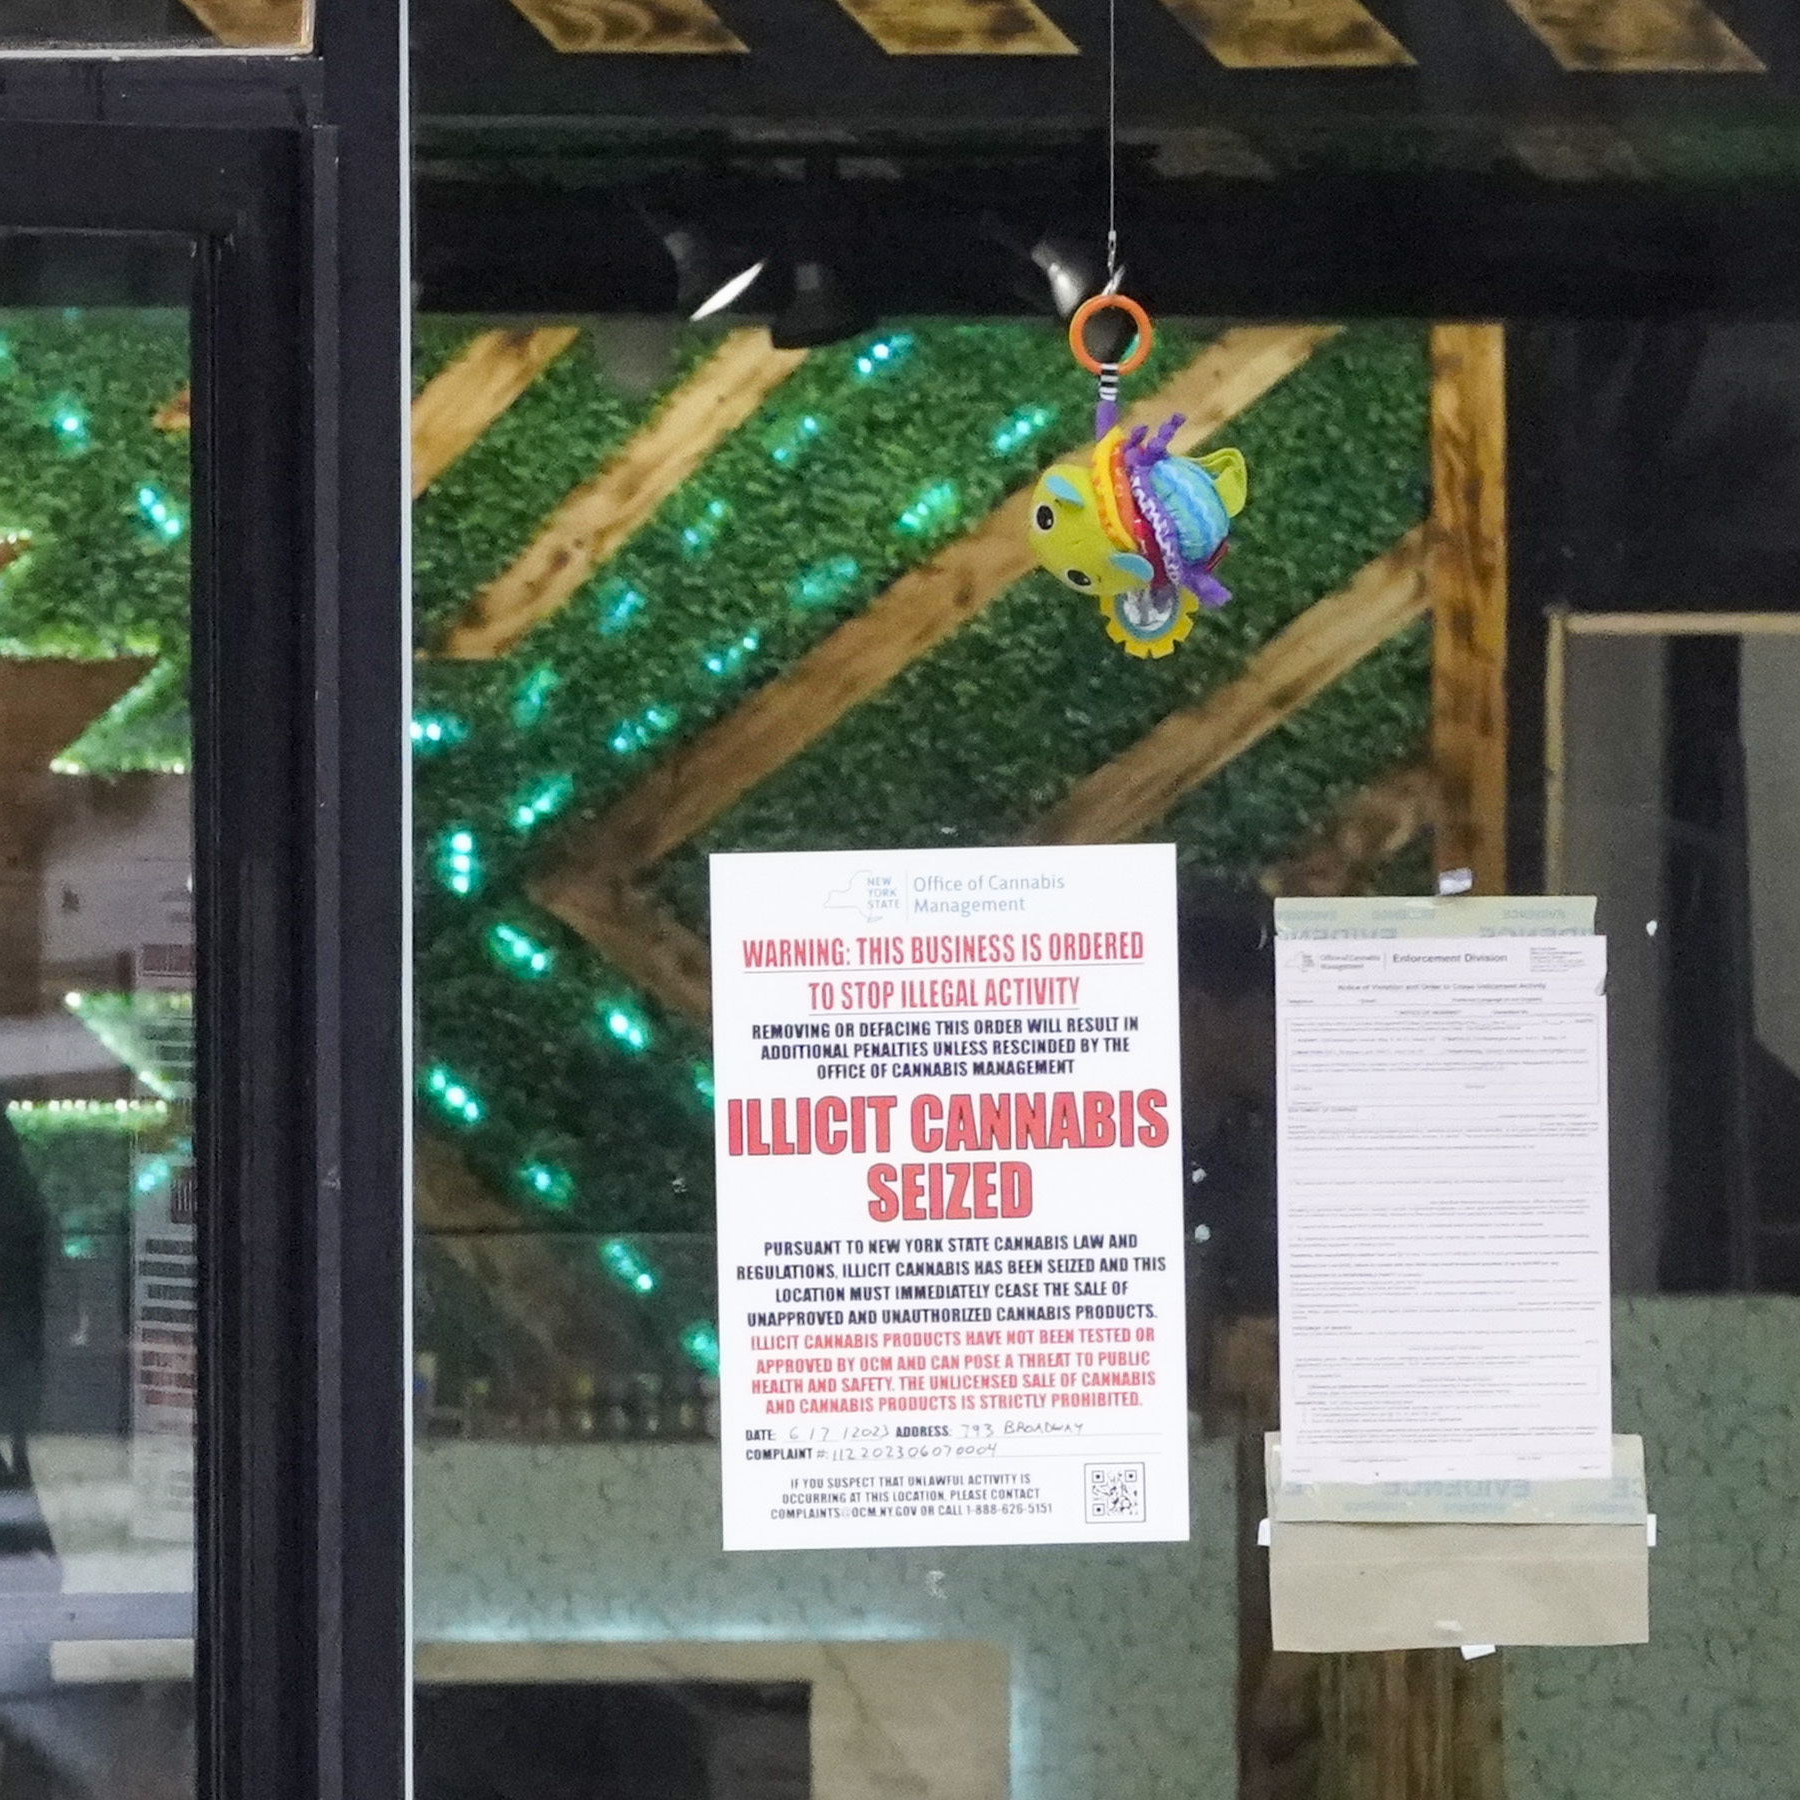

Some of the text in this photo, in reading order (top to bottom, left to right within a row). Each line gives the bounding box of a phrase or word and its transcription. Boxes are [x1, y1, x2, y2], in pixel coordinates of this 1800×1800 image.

[866, 875, 892, 887] NEW
[866, 886, 898, 898] YORK
[912, 873, 1066, 893] Office of Cannabis
[866, 897, 901, 910] STATE
[913, 895, 1026, 919] Management
[742, 931, 1144, 968] WARNING: THIS BUSINESS IS ORDERED
[1392, 953, 1508, 963] Enforcement Division
[808, 976, 1080, 1011] TO STOP ILLEGAL ACTIVITY
[752, 1016, 1139, 1040] REMOVING OR DEFACING THIS ORDER WILL RESULT IN
[760, 1036, 1130, 1061] ADDITIONAL PENALTIES UNLESS RESCINDED BY THE
[816, 1058, 1075, 1080] OFFICE OF CANNABIS MANAGEMENT
[727, 1088, 1170, 1157] ILLICIT CANNABIS
[866, 1159, 1033, 1223] SEIZED
[764, 1233, 1138, 1257] PURSUANT TO NEW YORK STATE CANNABIS LAW AND
[842, 1262, 891, 1278] ILLICIT
[895, 1260, 970, 1277] CANNABIS
[974, 1259, 1003, 1275] HAS
[1007, 1259, 1043, 1275] BEEN
[1047, 1257, 1095, 1274] SEIZED
[1099, 1257, 1129, 1273] AND
[1132, 1256, 1166, 1272] THIS
[775, 1280, 1128, 1303] LOCATION MUST IMMEDIATELY CEASE THE SALE OF
[747, 1303, 1157, 1327] UNAPPROVED AND UNAUTHORIZED CANNABIS PRODUCTS.
[750, 1327, 1155, 1351] ILLICIT CANNABIS PRODUCTS HAVE NOT BEEN TESTED OR
[756, 1350, 1150, 1374] APPROVED BY OCM AND CAN POSE A THREAT TO PUBLIC
[751, 1370, 1156, 1394] HEALTH AND SAFETY. THE UNLICENSED SALE OF CANNABIS
[765, 1391, 1142, 1414] AND CANNABIS PRODUCTS IS STRICTLY PROHIBITED.
[895, 1424, 952, 1438] ADDRESS:
[1003, 1418, 1084, 1437] BROADWAY
[745, 1447, 813, 1461] COMPLAINT
[790, 1473, 1031, 1489] IF YOU SUSPECT THAT UNLAWFUL ACTIVITY IS
[782, 1492, 847, 1505] OCCURRING
[849, 1491, 861, 1503] AT
[865, 1491, 889, 1503] THIS
[950, 1489, 987, 1501] PLEASE
[990, 1487, 1039, 1500] CONTACT
[920, 1504, 935, 1517] OR
[937, 1504, 964, 1517] CALL
[966, 1501, 1053, 1516] 1-888-626-5151
